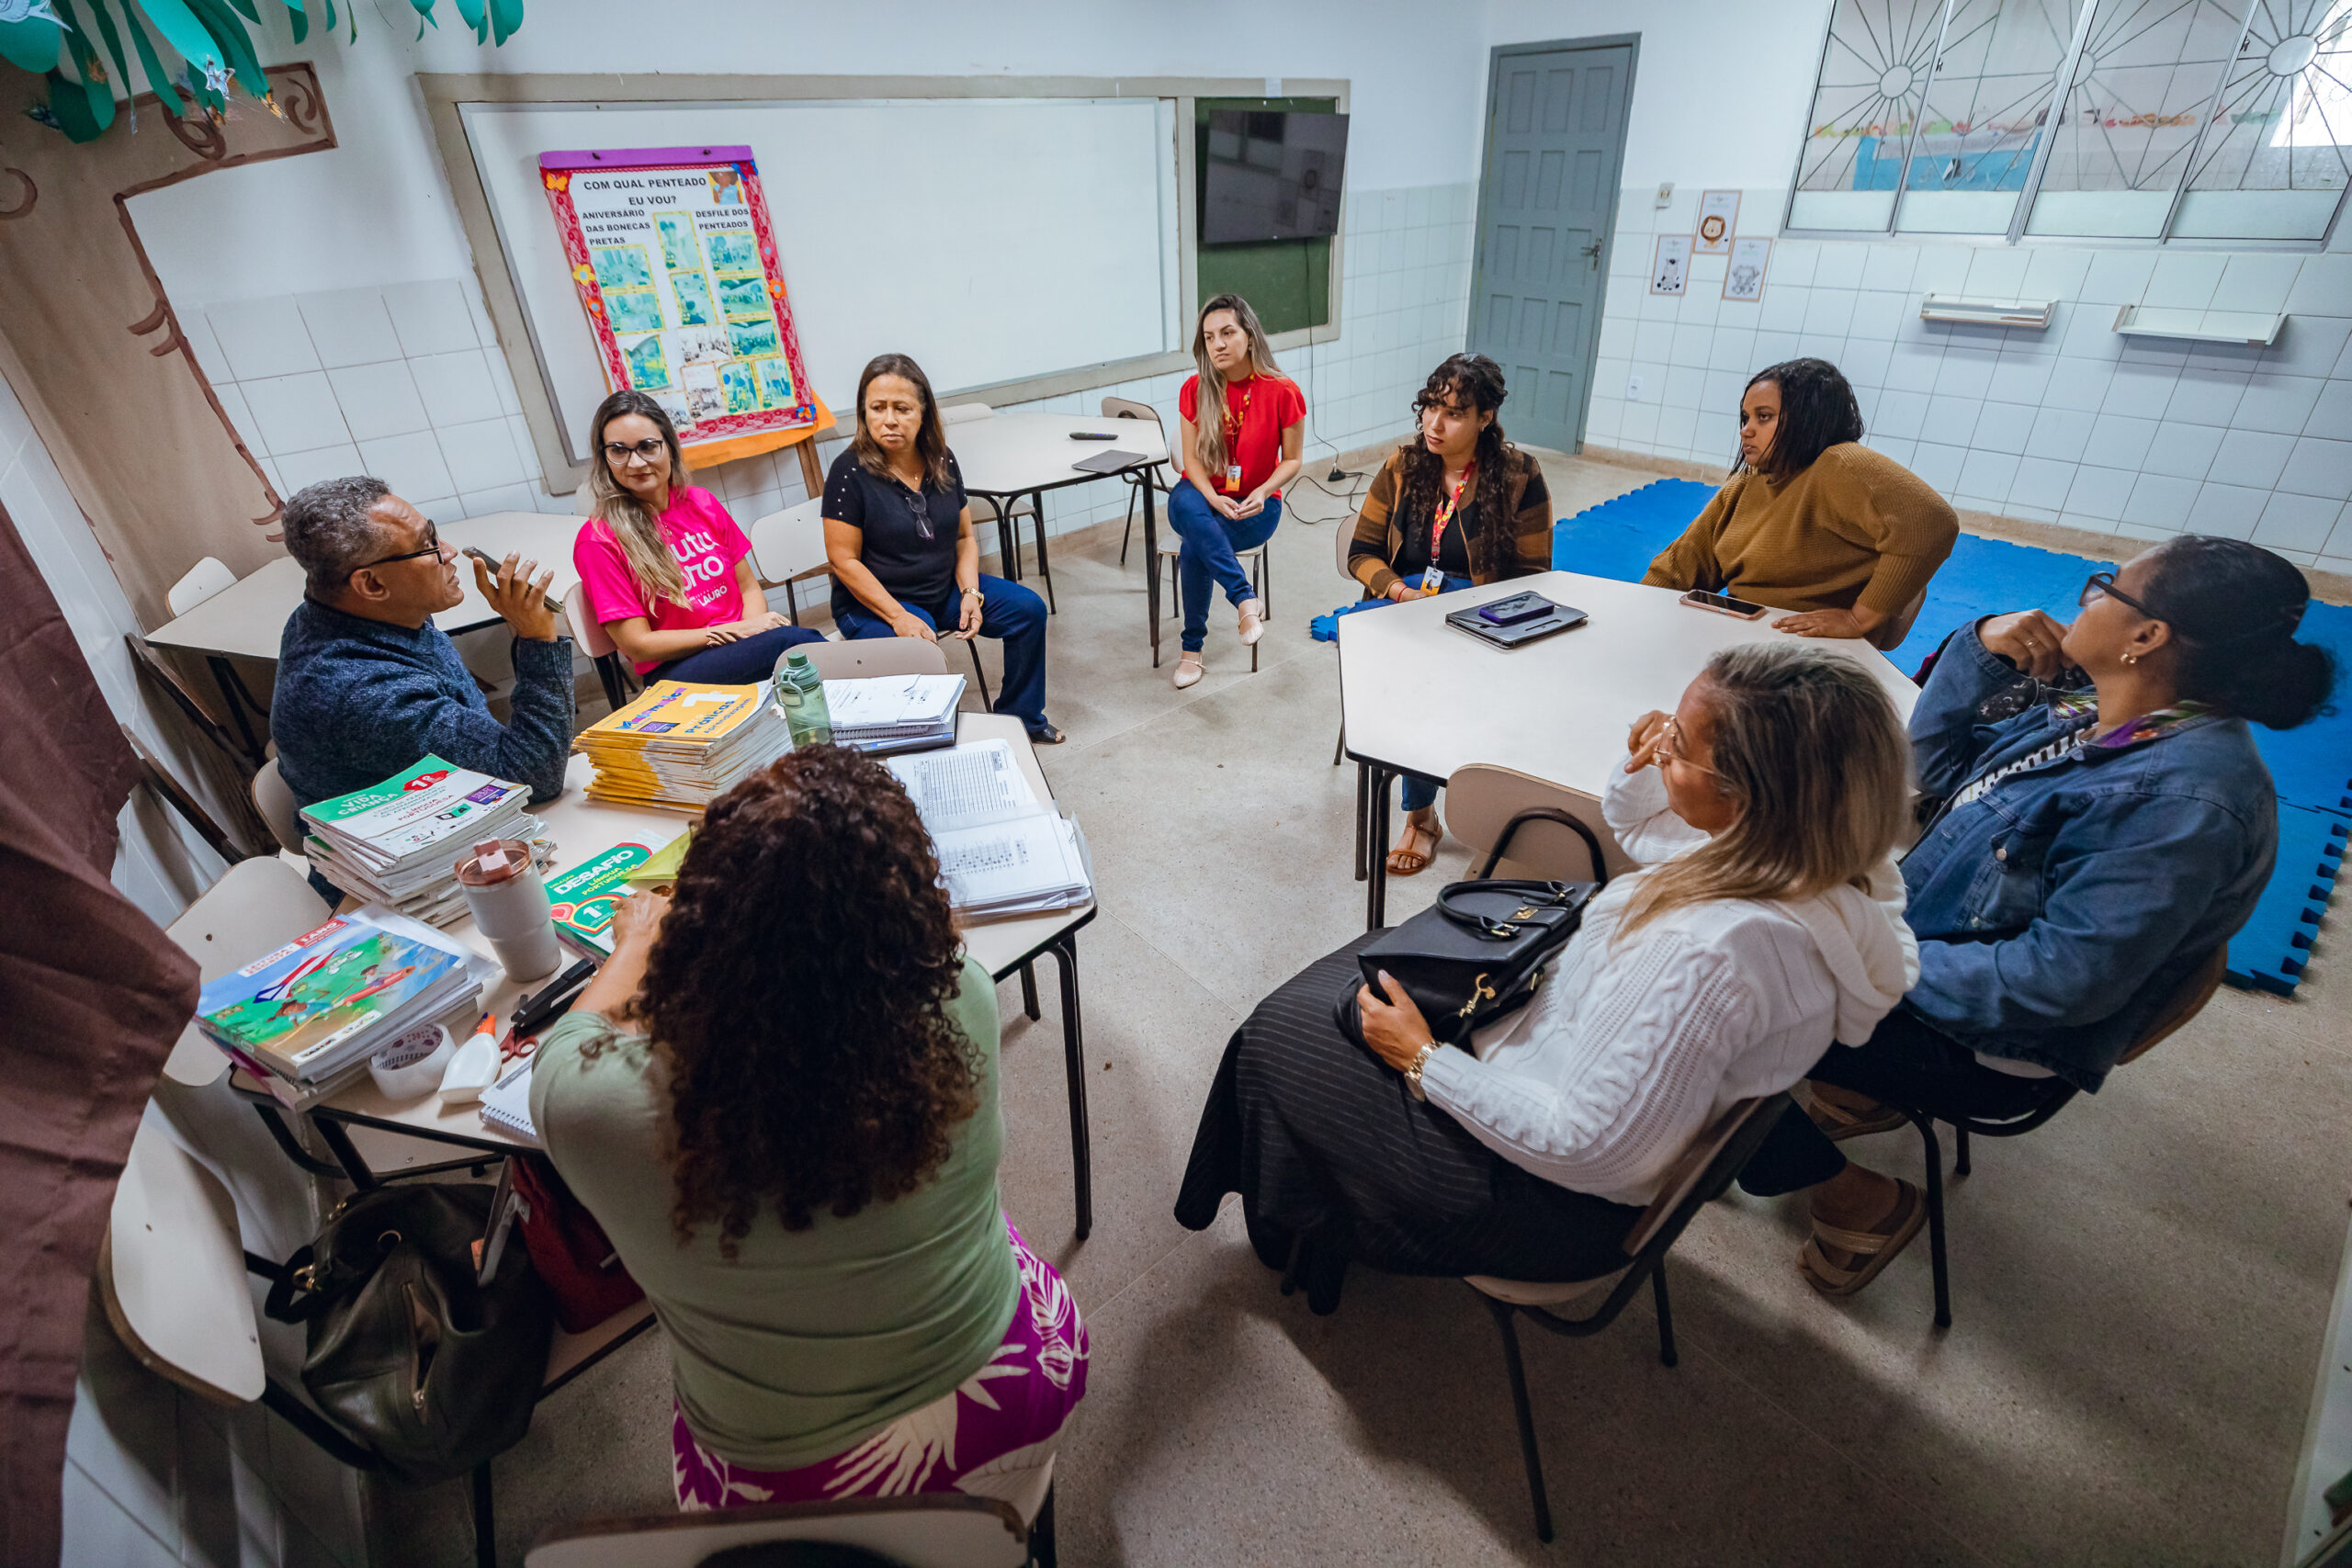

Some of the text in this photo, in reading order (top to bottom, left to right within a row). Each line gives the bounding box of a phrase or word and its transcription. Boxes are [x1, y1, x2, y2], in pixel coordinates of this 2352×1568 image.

[583, 177, 707, 190] COM QUAL PENTEADO
[628, 196, 676, 205] EU VOU?
[582, 209, 645, 220] ANIVERSÁRIO
[695, 209, 729, 218] DESFILE
[607, 222, 650, 231] BONECAS
[699, 220, 749, 230] PENTEADOS
[589, 237, 626, 245] PRETAS
[670, 532, 720, 562] utu
[698, 585, 728, 606] LAURO
[338, 794, 399, 815] CRIANÇA
[341, 794, 381, 807] VIDA
[553, 850, 634, 895] DESAFIO
